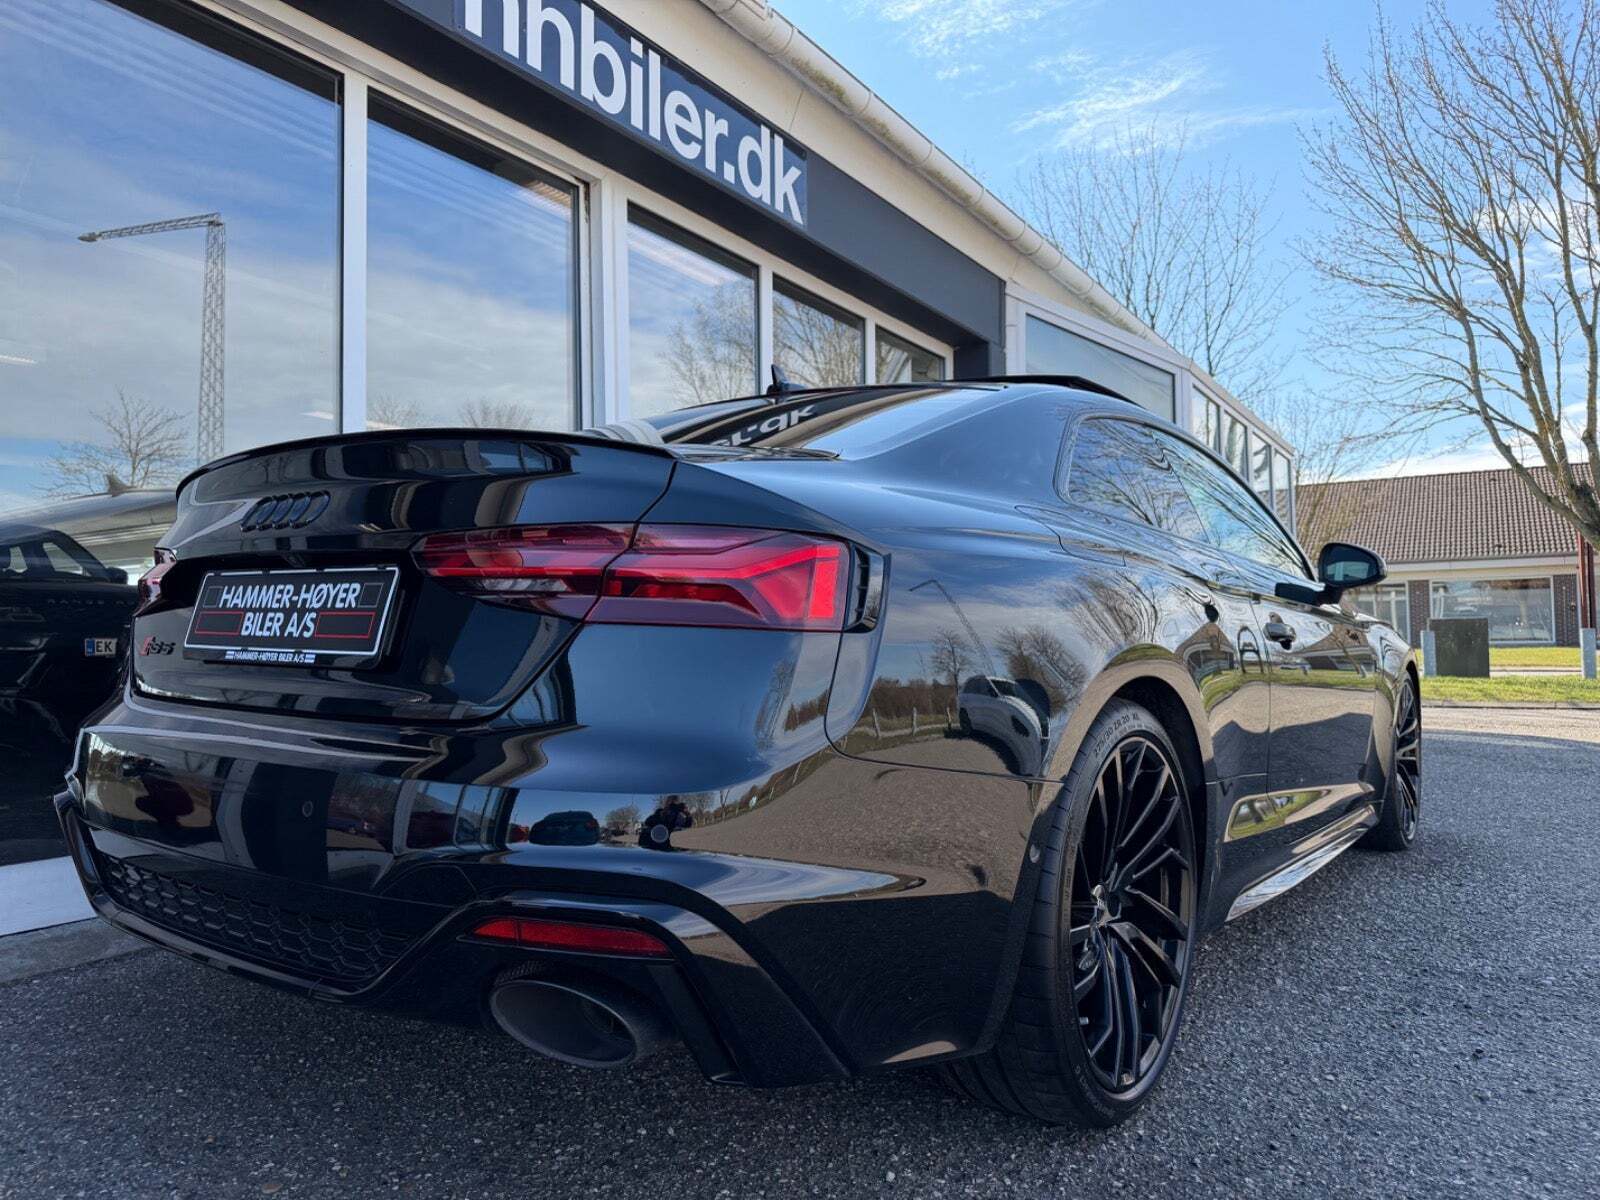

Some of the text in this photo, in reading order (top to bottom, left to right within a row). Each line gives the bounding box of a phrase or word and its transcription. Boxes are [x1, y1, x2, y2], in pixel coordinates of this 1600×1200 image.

[219, 583, 361, 609] HAMMER-HØYER
[240, 611, 317, 638] BILER A/S
[95, 641, 113, 653] EK
